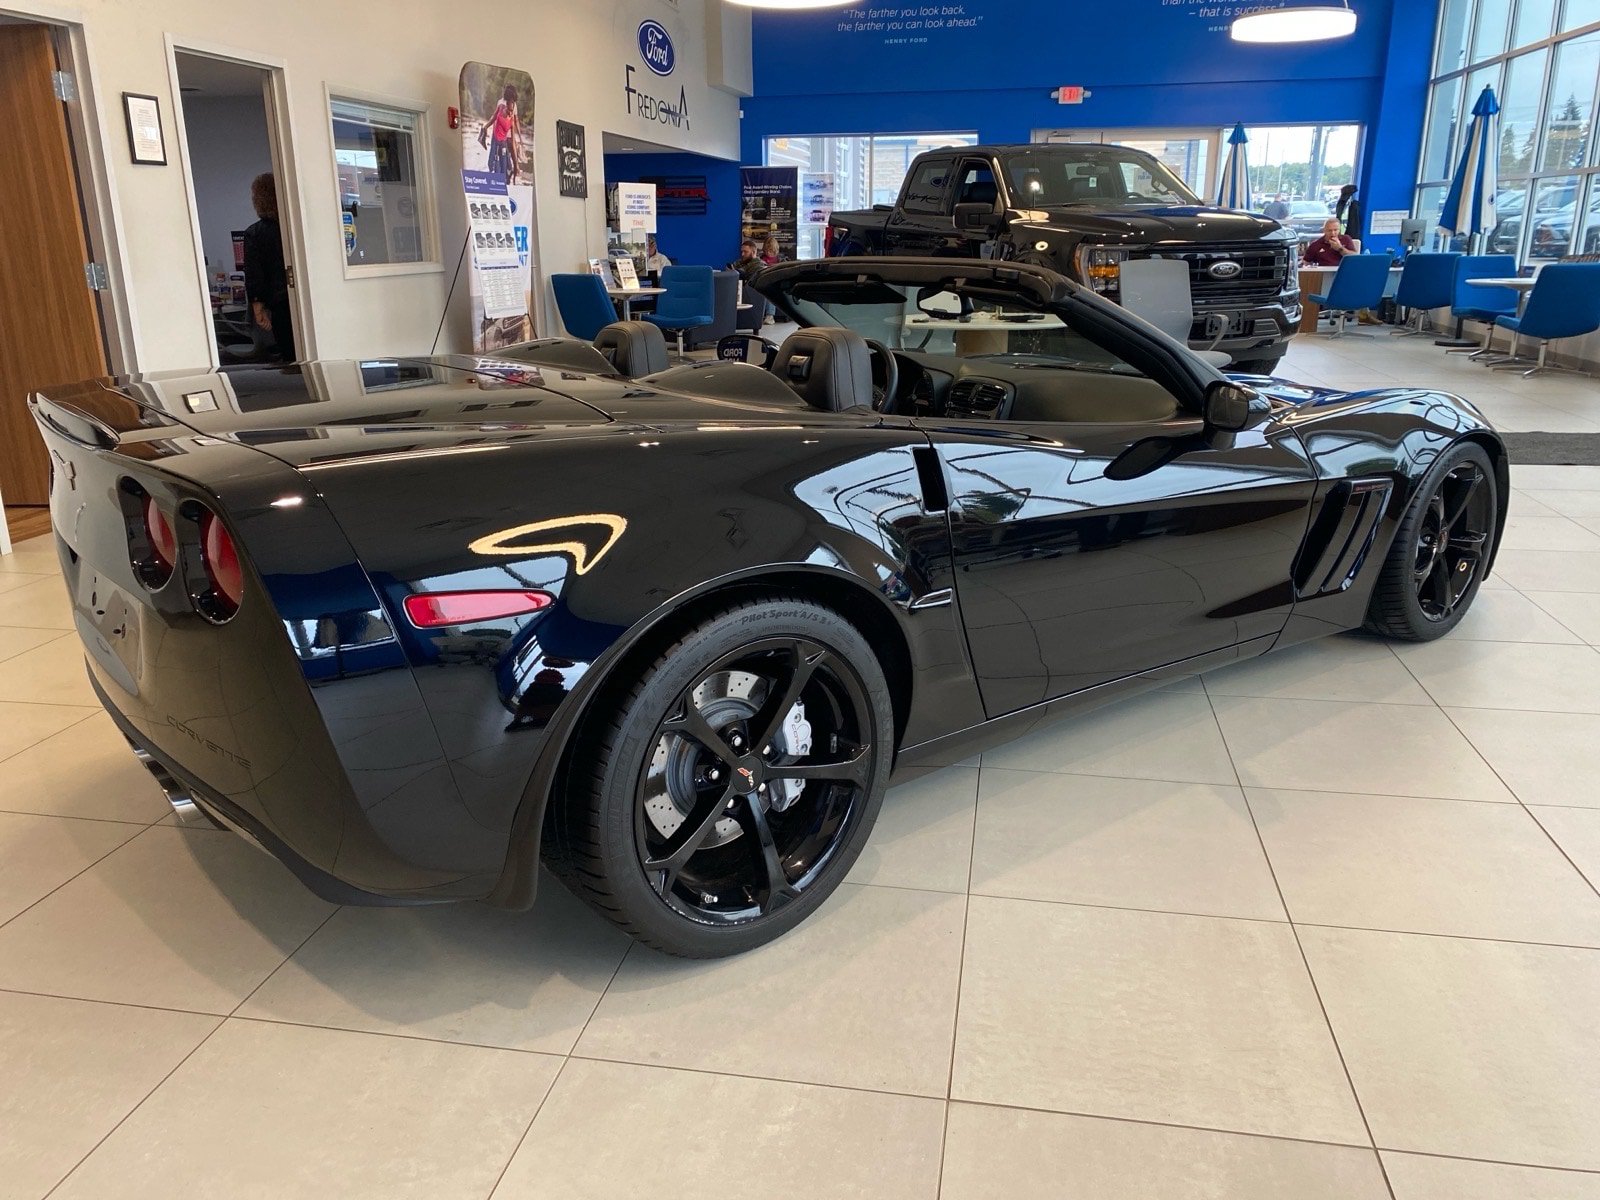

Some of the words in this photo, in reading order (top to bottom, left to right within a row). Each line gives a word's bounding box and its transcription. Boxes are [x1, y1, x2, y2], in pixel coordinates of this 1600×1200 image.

[868, 8, 898, 19] farther
[900, 9, 917, 18] you
[920, 6, 939, 16] look
[941, 5, 965, 15] back.
[1199, 6, 1220, 18] that
[1222, 6, 1232, 16] is
[837, 22, 852, 32] the
[854, 21, 884, 33] farther
[886, 22, 903, 32] you
[905, 20, 922, 30] can
[924, 18, 944, 28] look
[624, 63, 690, 131] FREDONIA
[741, 611, 769, 626] Pilot
[769, 609, 799, 620] Sport
[800, 611, 819, 622] A/S
[166, 713, 252, 769] CORVETTE
